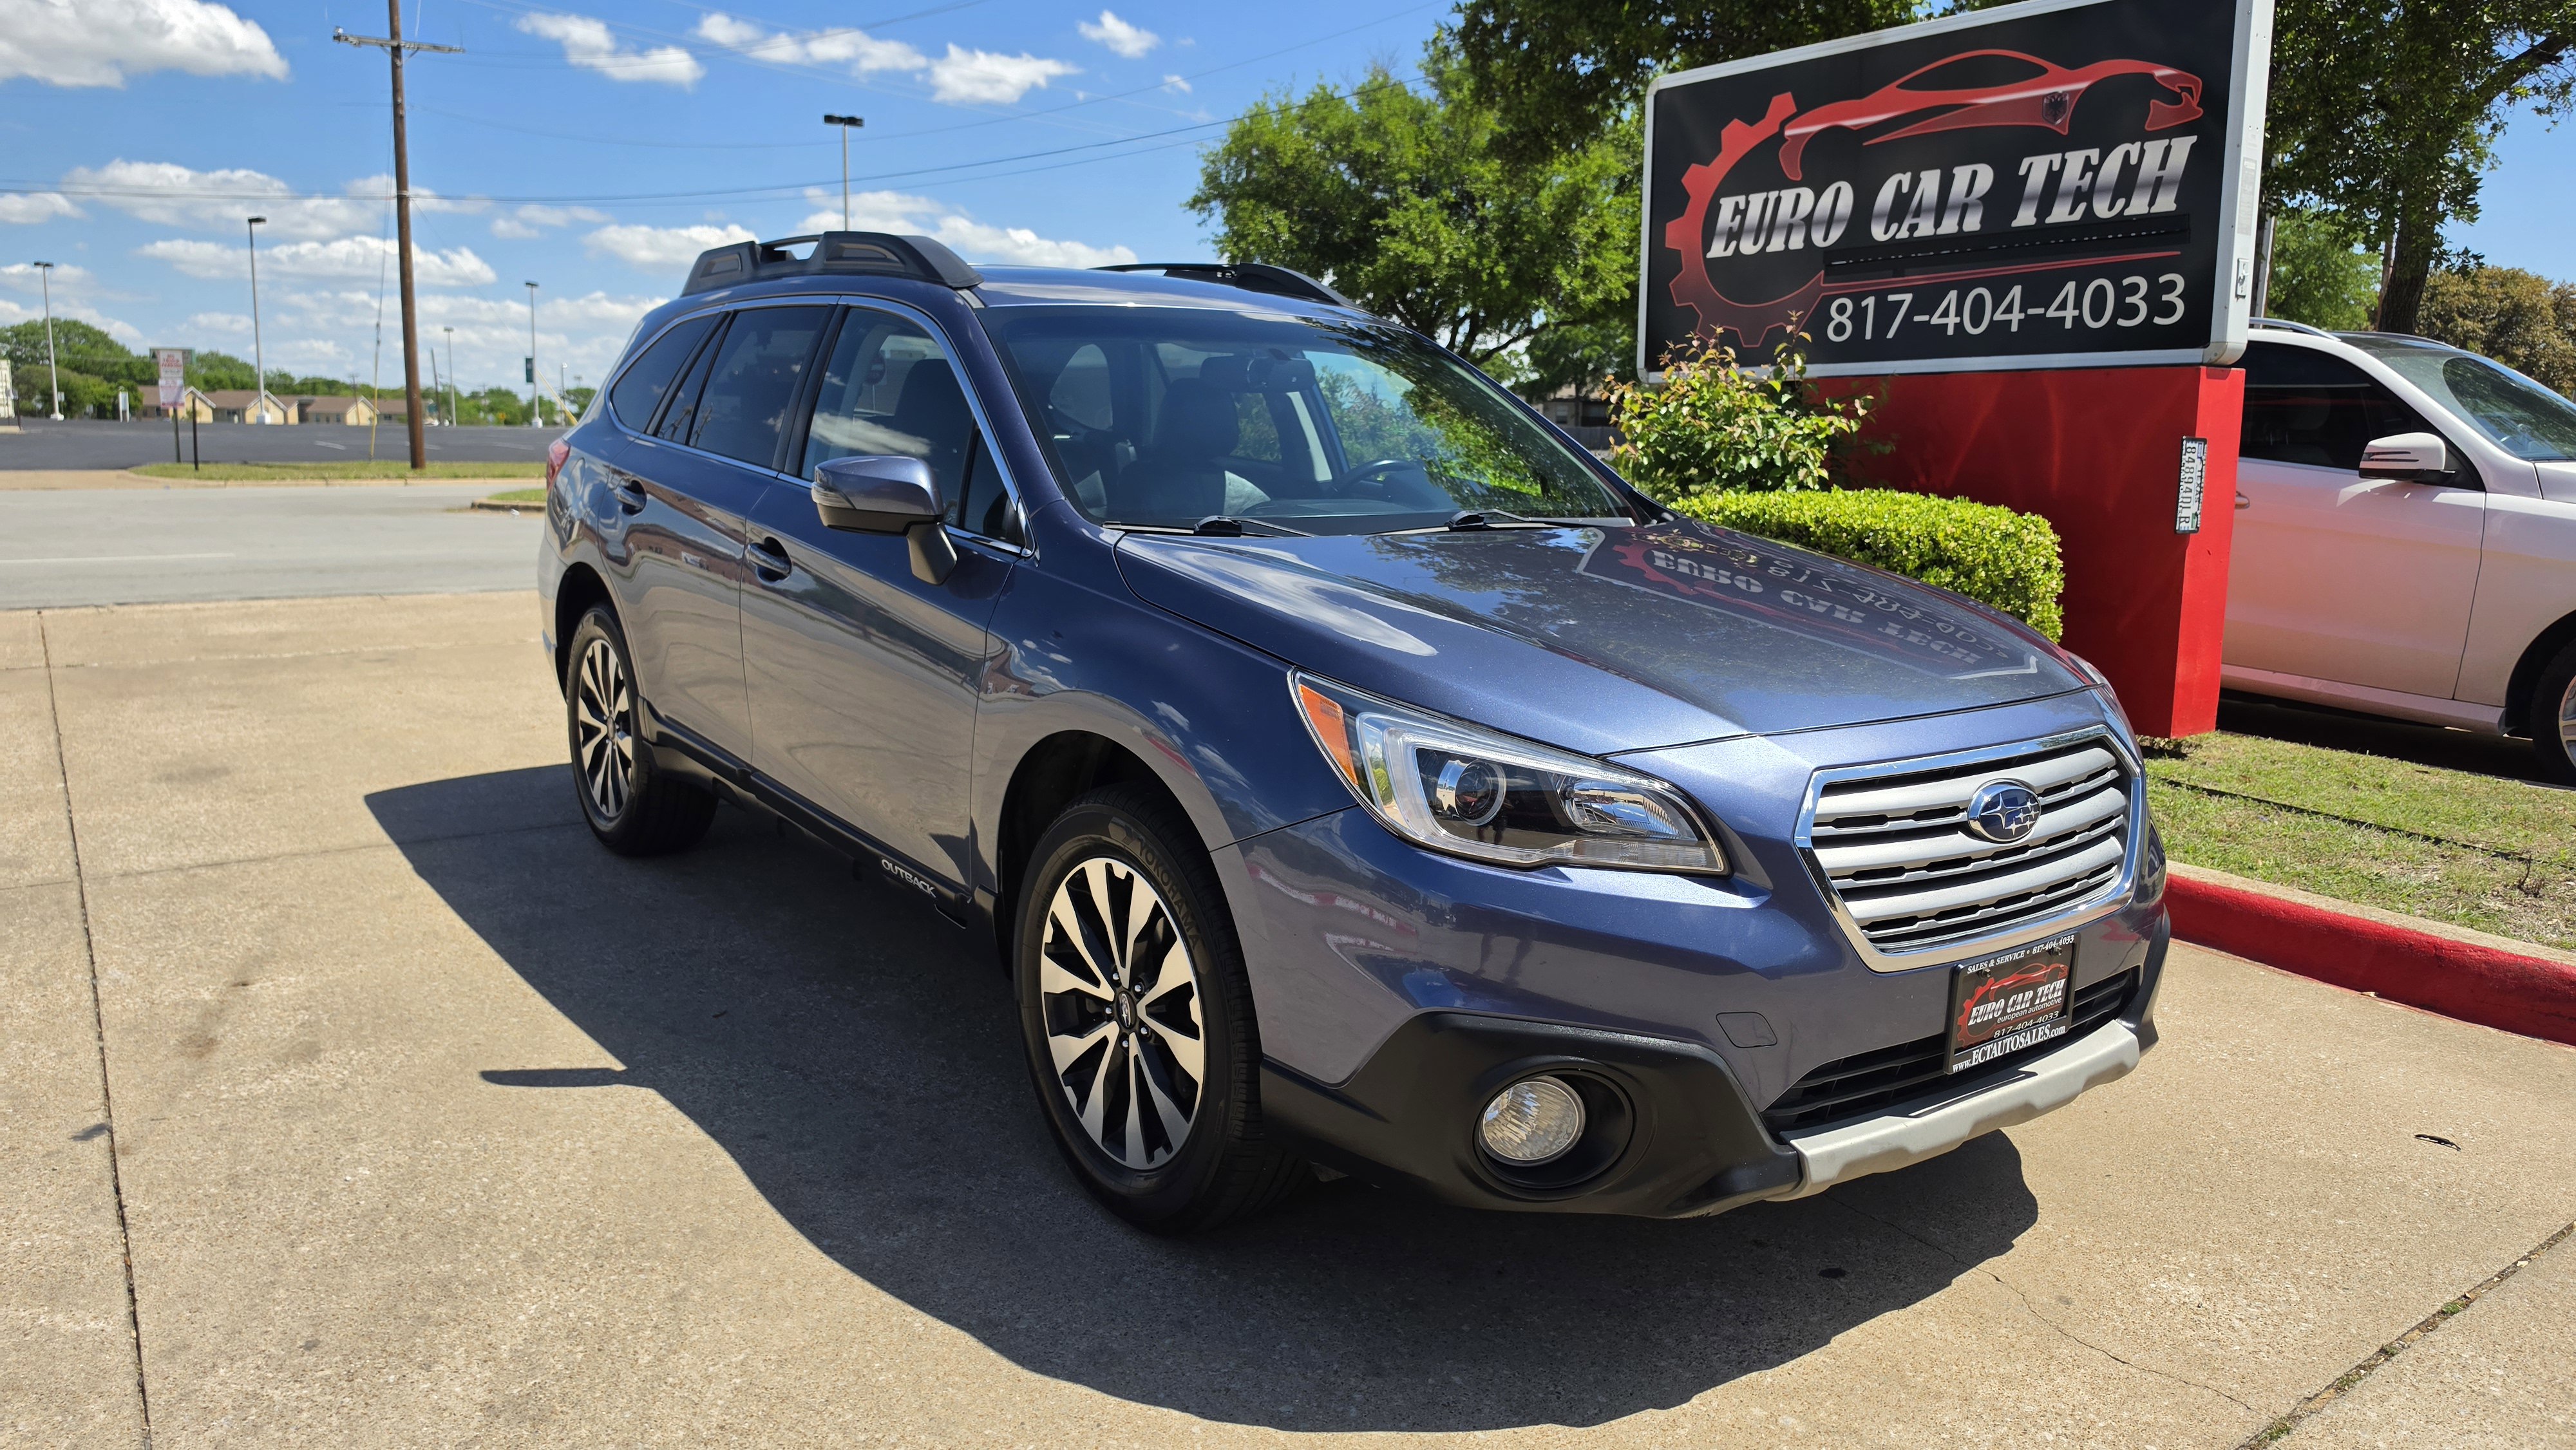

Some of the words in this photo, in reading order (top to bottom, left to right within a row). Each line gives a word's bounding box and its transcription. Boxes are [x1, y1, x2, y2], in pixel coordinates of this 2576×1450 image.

[1707, 180, 1853, 259] EURO
[1870, 162, 1994, 242] CAR
[2011, 135, 2197, 227] TECH
[1827, 272, 2186, 342] 817-404-4033
[882, 859, 936, 898] OUTBACK
[1137, 836, 1200, 950] YOKOHAMA
[1967, 963, 1987, 974] SALES
[1996, 950, 2025, 965] SERVICE
[2032, 935, 2074, 954] 817-404-4033
[1967, 998, 2005, 1026] EURO
[2007, 990, 2034, 1013] CAR
[2034, 978, 2067, 1004] TECH
[1993, 1010, 2059, 1039] 817-404-4033
[1997, 1008, 2027, 1024] european
[2028, 997, 2062, 1015] automotive
[1952, 1024, 2066, 1073] www.ECTAUTOSALES.com
